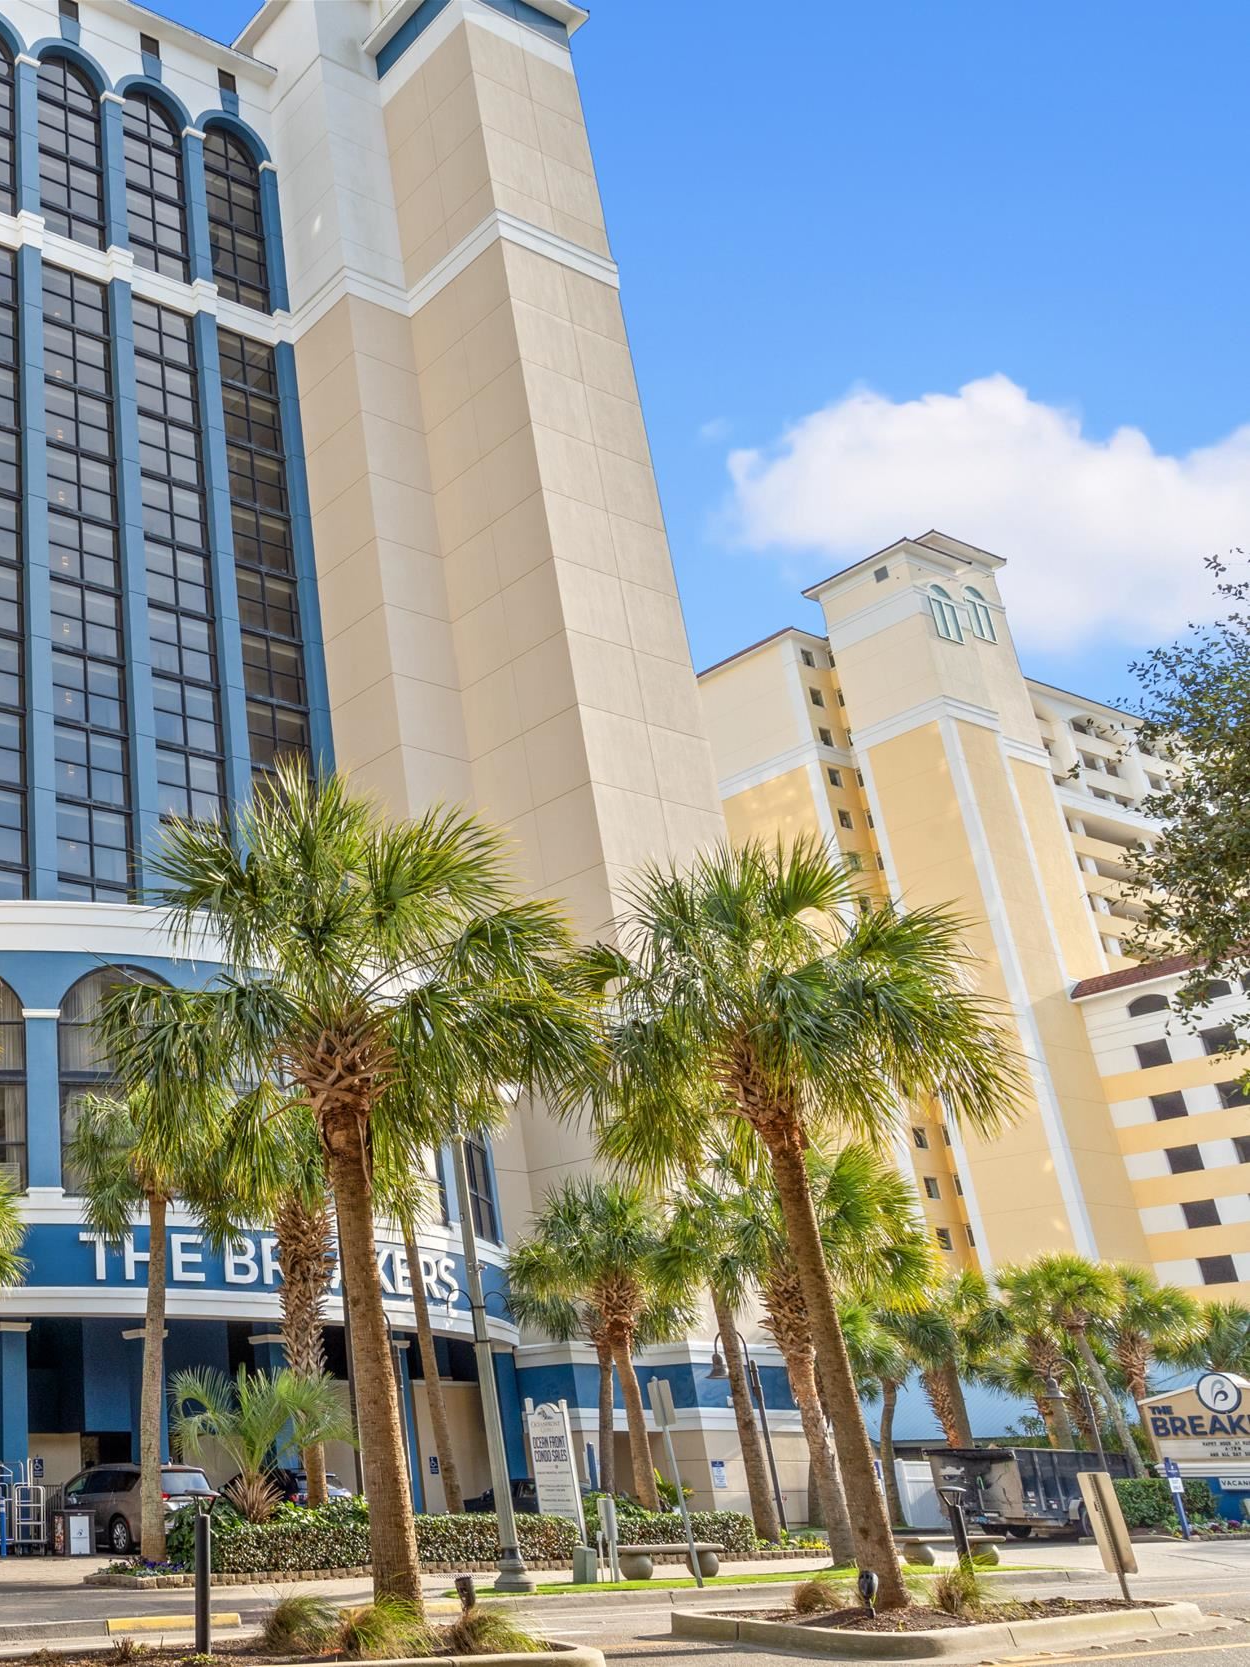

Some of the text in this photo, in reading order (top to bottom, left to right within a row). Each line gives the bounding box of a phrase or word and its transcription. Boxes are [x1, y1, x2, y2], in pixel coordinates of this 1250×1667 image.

[78, 1231, 460, 1303] THE BRKERS
[1148, 1405, 1174, 1415] THE
[1151, 1414, 1250, 1437] BREAK
[532, 1435, 565, 1449] OCEAN FRONT
[534, 1449, 568, 1462] CONDO SALES
